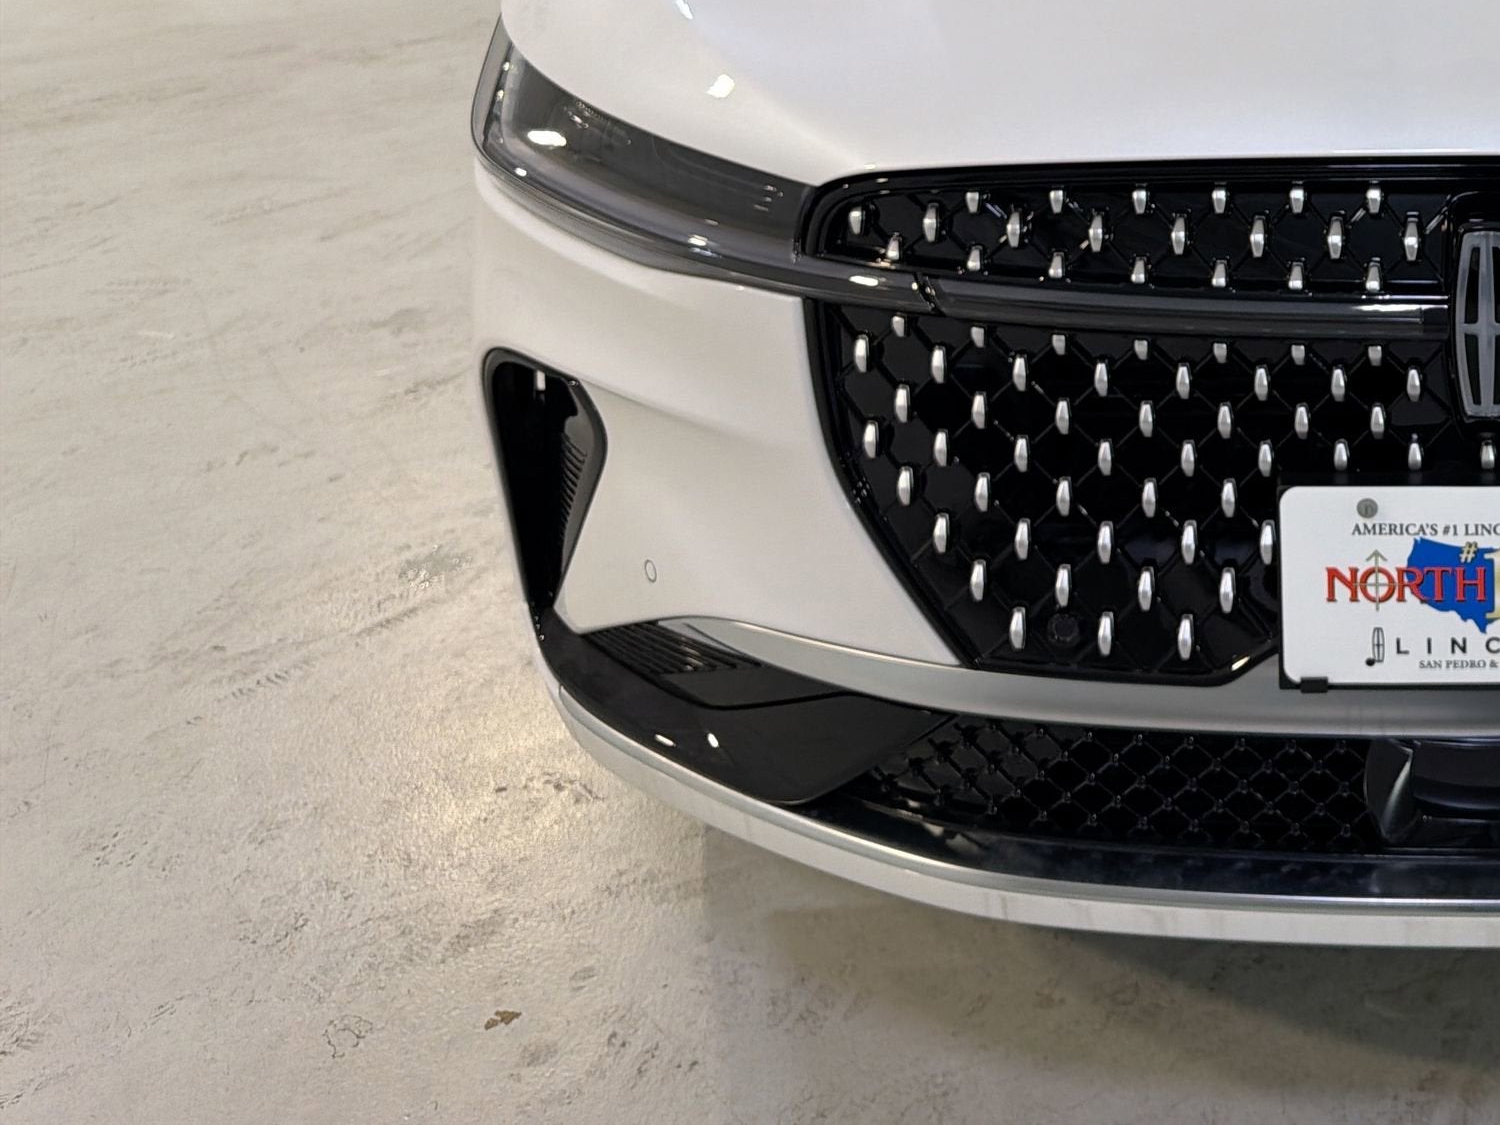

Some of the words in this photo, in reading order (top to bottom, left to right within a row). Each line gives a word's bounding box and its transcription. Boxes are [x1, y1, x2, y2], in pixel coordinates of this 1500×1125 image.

[1351, 522, 1439, 536] AMERICA'S
[1442, 522, 1459, 536] #1
[1325, 566, 1487, 604] NORTH
[1418, 659, 1443, 670] SAN
[1445, 659, 1487, 670] PEDRO
[1489, 659, 1498, 669] &
